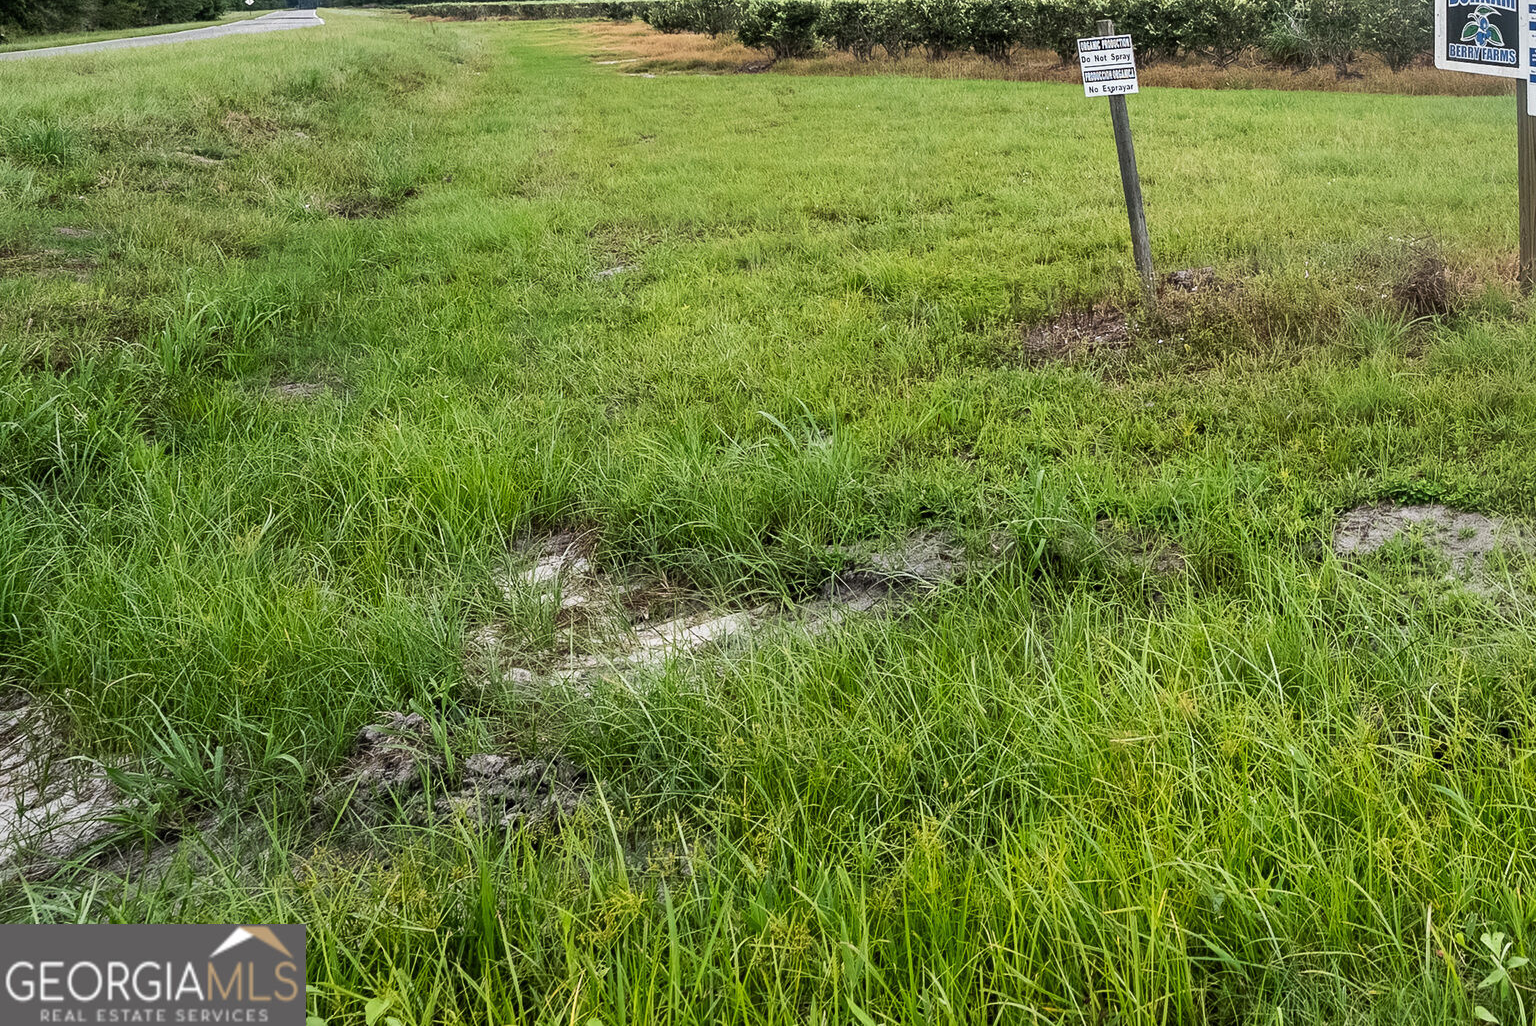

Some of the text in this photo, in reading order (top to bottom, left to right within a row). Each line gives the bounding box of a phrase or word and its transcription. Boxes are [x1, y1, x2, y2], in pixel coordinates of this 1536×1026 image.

[1081, 53, 1131, 64] Do Not Spray
[1448, 43, 1481, 61] BERRY
[1480, 46, 1517, 65] FARMS
[1102, 84, 1134, 93] Esprayar
